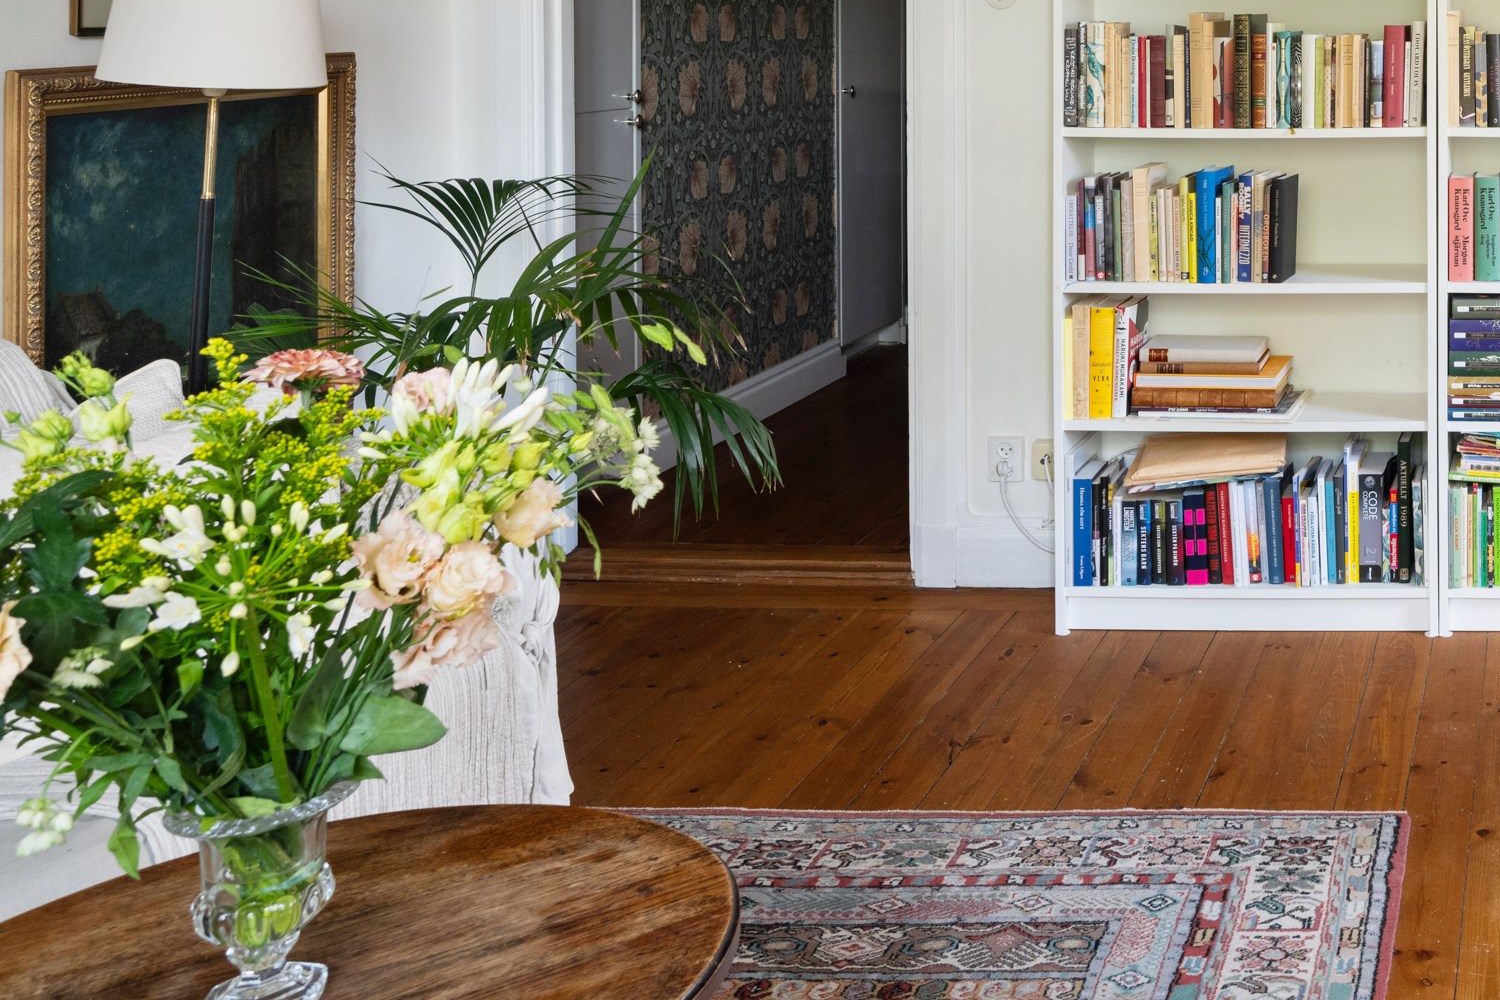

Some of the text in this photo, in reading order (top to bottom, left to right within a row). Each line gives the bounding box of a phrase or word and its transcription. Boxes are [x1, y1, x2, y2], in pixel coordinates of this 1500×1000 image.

[1453, 188, 1462, 230] Knausgård
[1479, 187, 1488, 230] Knausgård
[1488, 187, 1496, 221] Karl Ove
[1453, 236, 1461, 267] stjärnan
[1460, 236, 1469, 265] Morgon
[1368, 490, 1378, 520] CODE
[1400, 460, 1408, 527] AKTUELLT 1989
